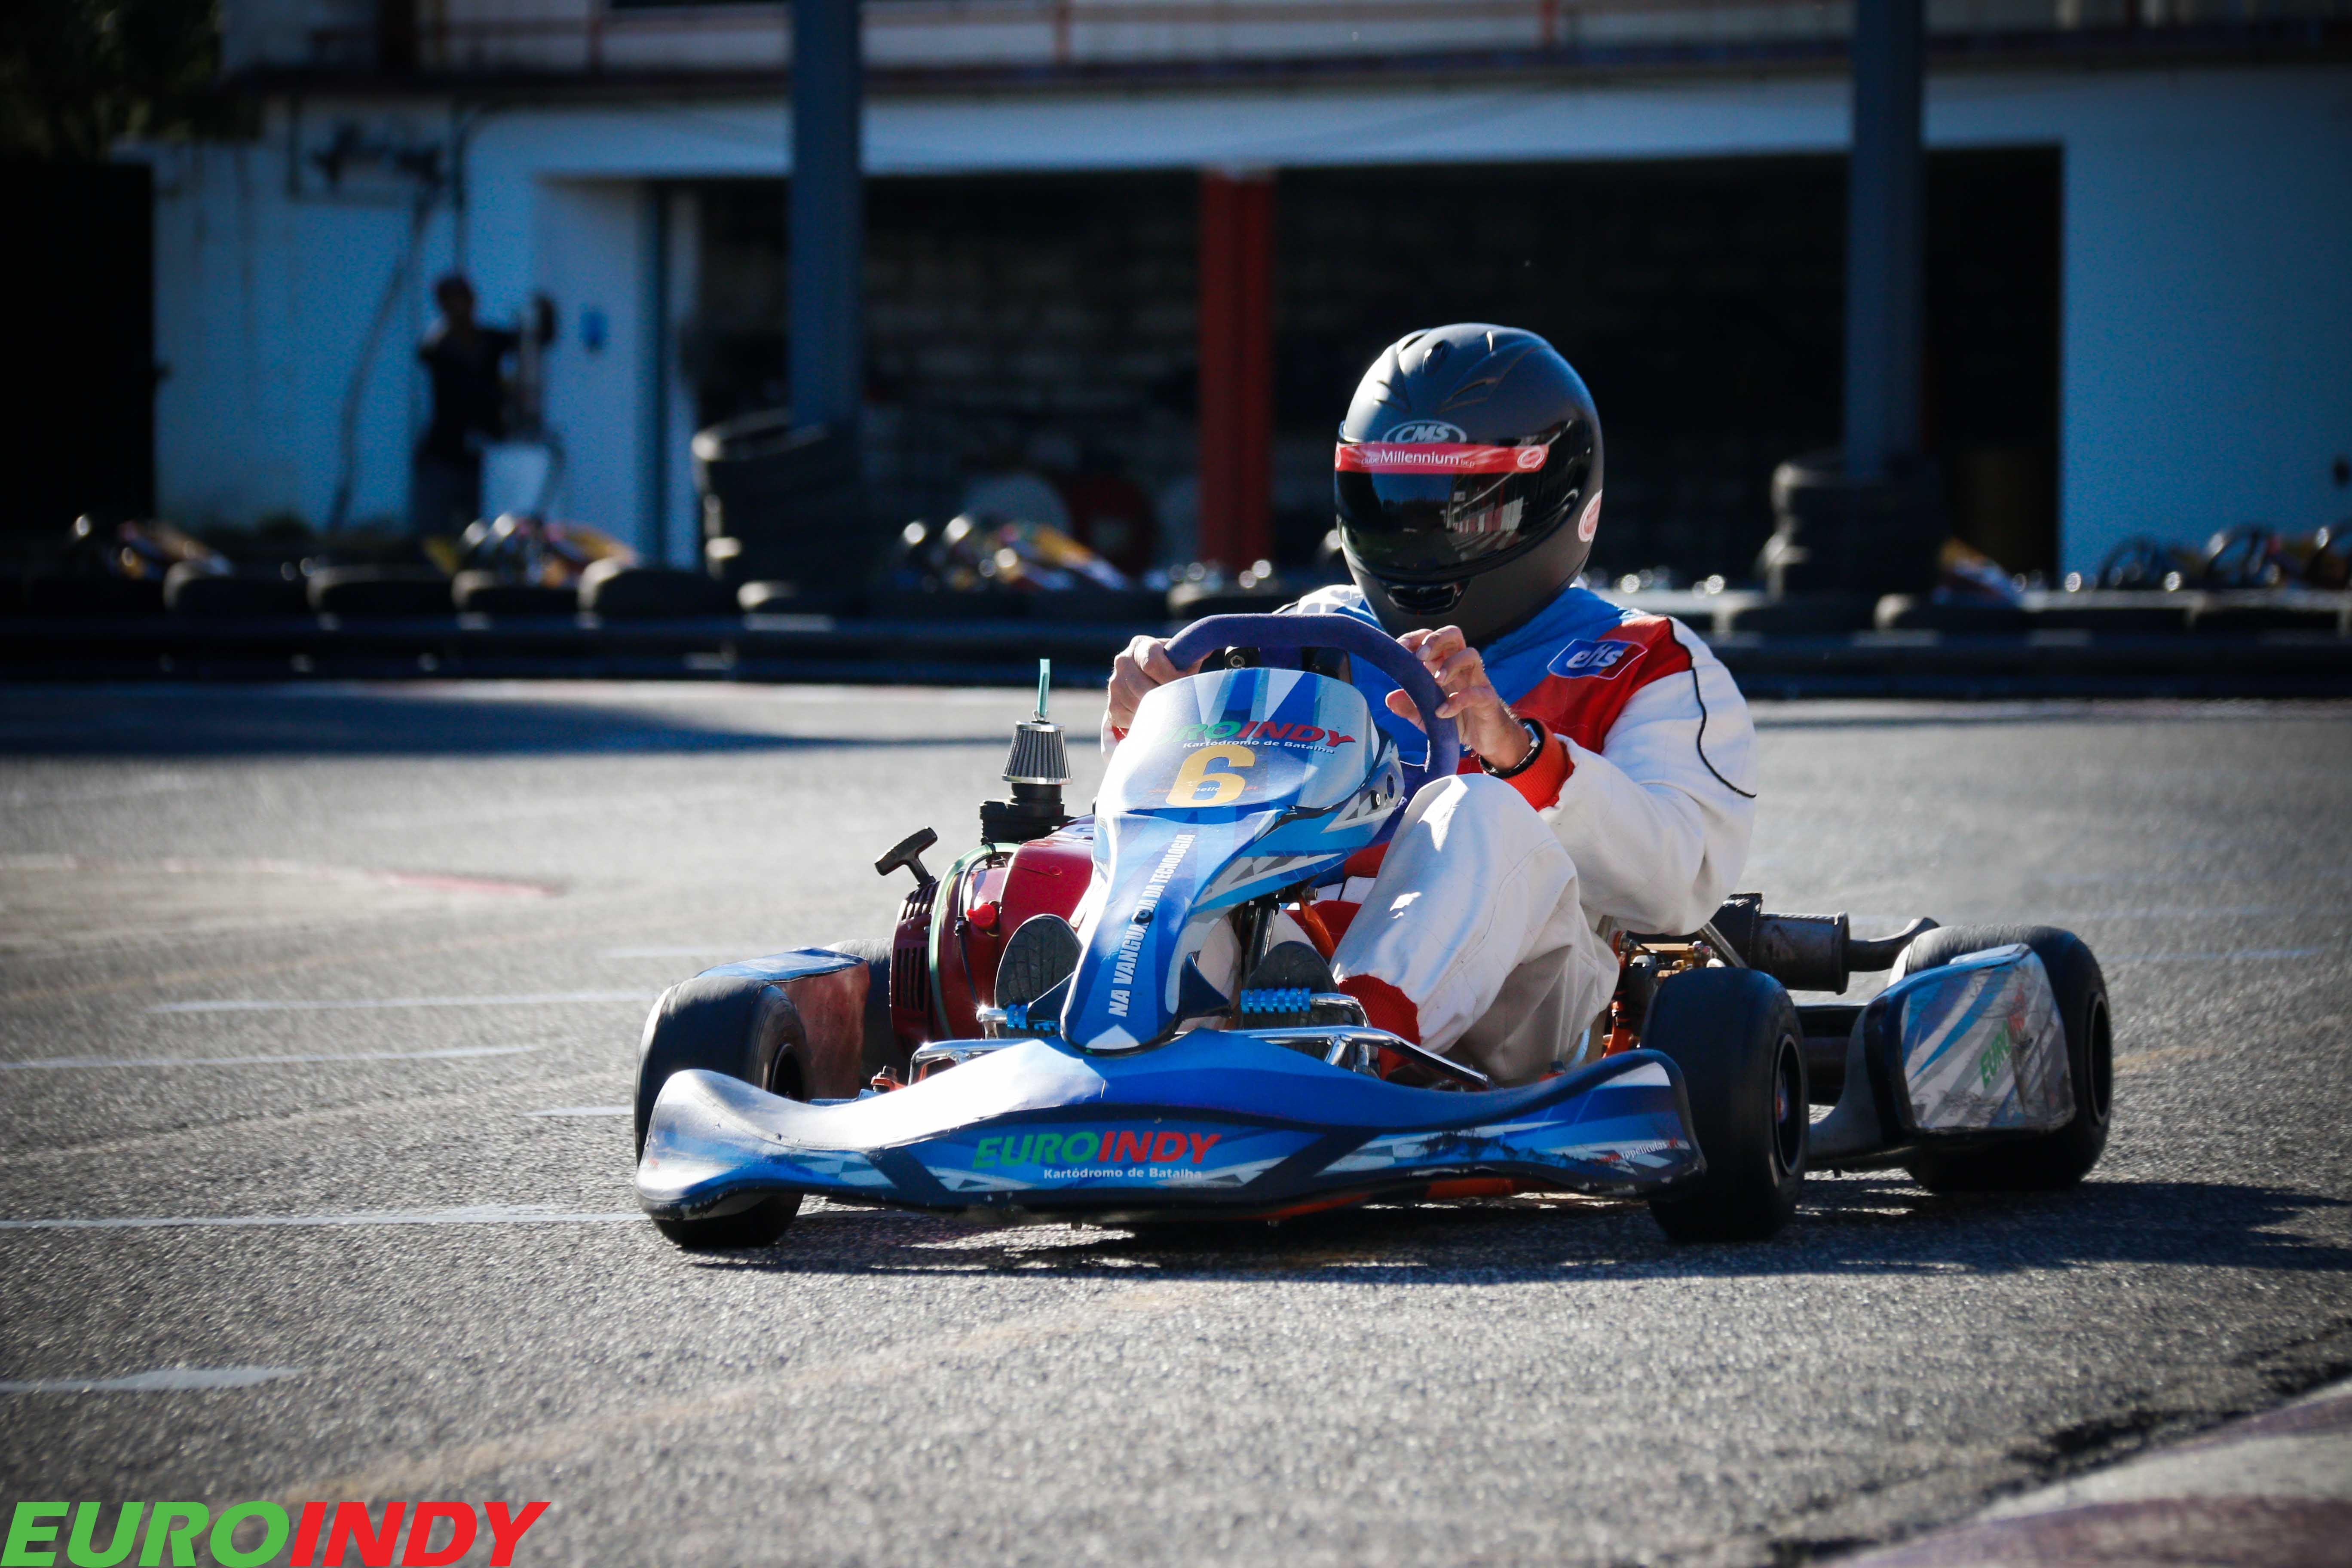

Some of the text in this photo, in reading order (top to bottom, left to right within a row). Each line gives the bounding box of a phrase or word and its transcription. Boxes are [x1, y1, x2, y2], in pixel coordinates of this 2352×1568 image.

[1396, 425, 1449, 443] CMS
[1380, 449, 1459, 465] Millennium
[1157, 720, 1356, 747] ROINDY
[1182, 740, 1259, 748] Kartódromo
[1284, 741, 1335, 754] Batalha
[1165, 745, 1256, 807] 6
[1108, 834, 1196, 1017] NA VANGUADA DA TECNOLOGIA
[972, 1131, 1222, 1169] EUROINDY
[1044, 1167, 1202, 1179] Kartódromo de Batalha
